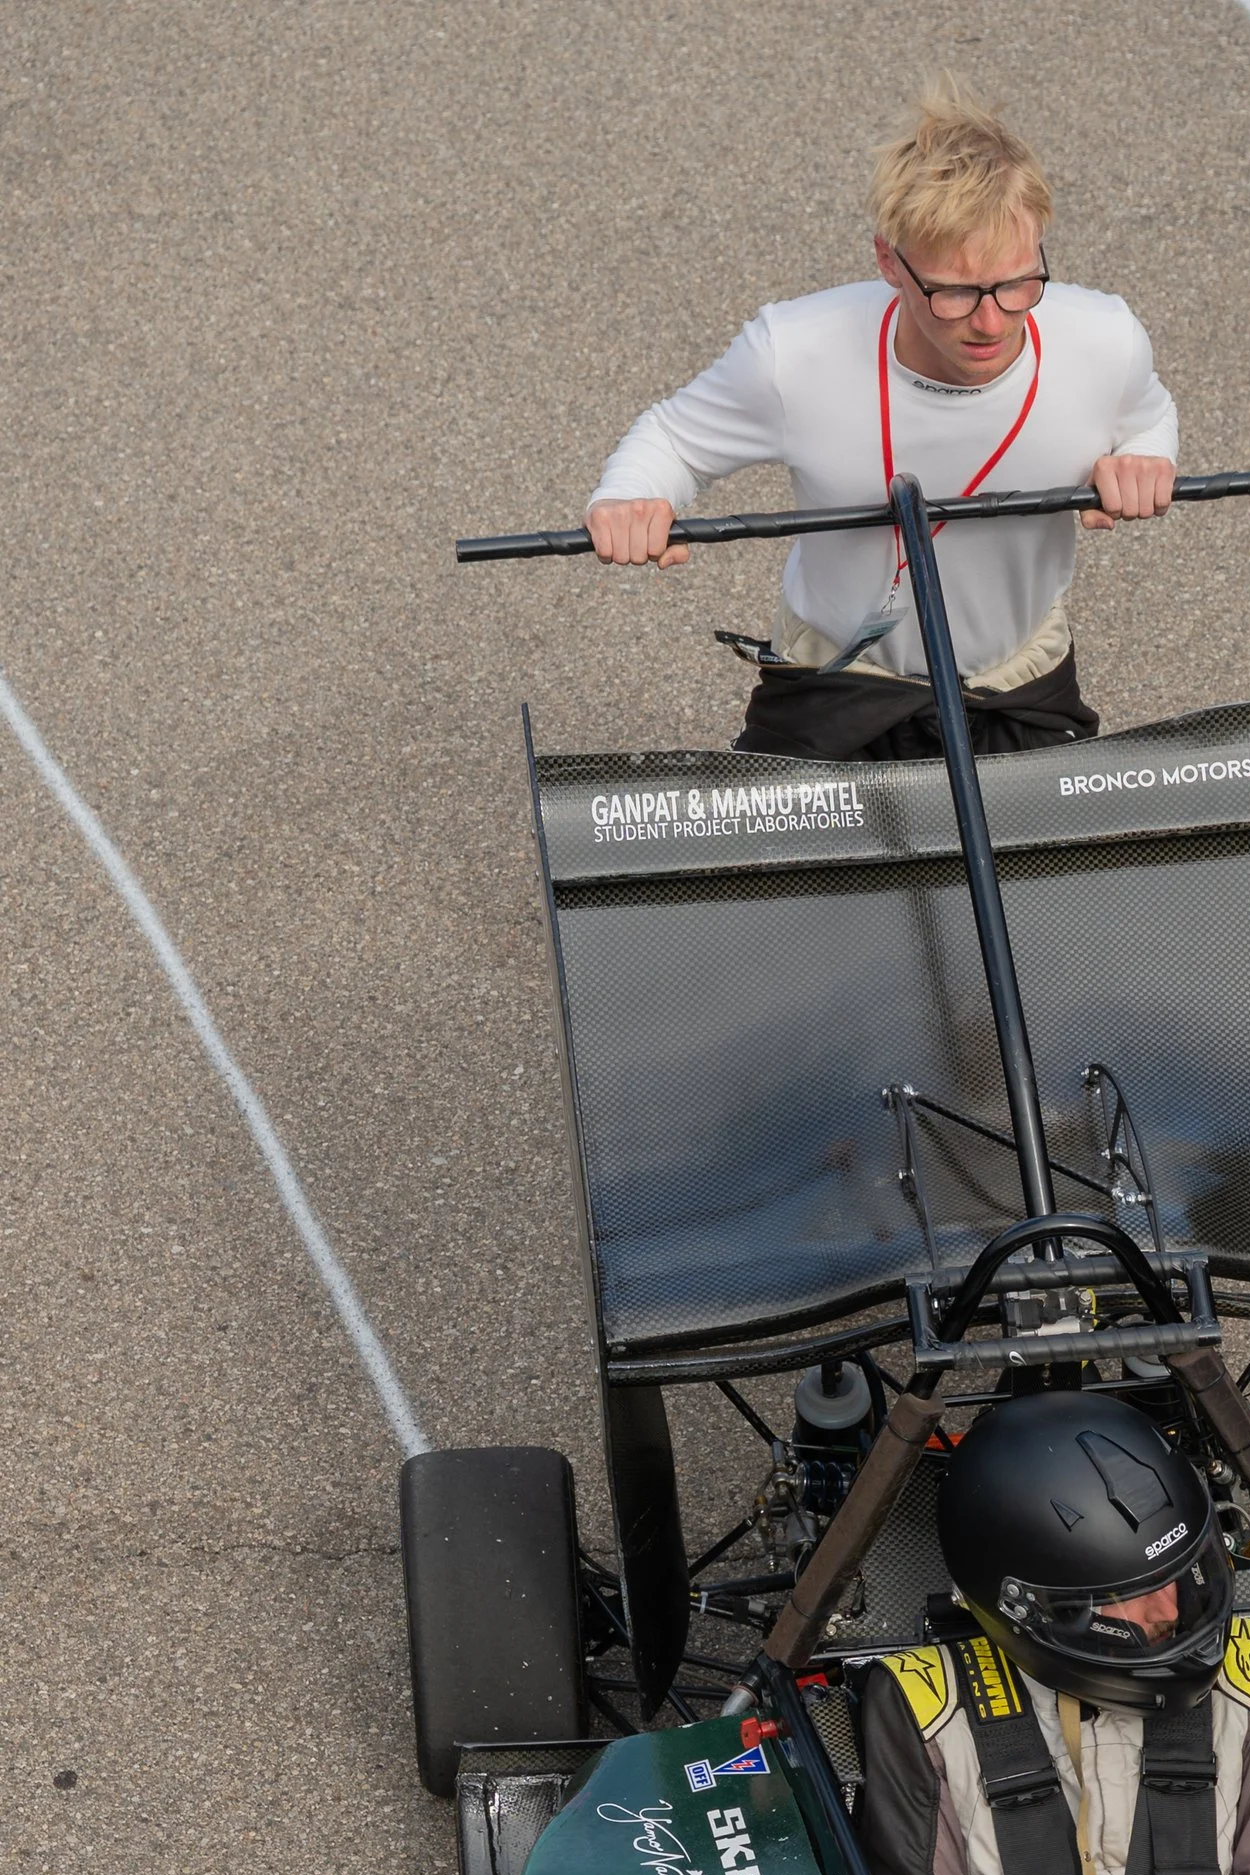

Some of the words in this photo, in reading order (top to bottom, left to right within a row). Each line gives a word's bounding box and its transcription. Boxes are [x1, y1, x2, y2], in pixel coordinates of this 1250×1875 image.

[1059, 769, 1156, 796] BRONCO
[591, 791, 680, 826] GANPAT
[687, 789, 706, 820] &
[712, 785, 794, 818] MANJU
[800, 781, 864, 813] PATEL
[594, 822, 668, 843] STUDENT
[673, 818, 742, 838] PROJECT
[747, 811, 864, 834] LABORATORIES
[1145, 1522, 1189, 1560] sparco
[1090, 1622, 1130, 1639] sparco
[969, 1636, 1010, 1716] CHROTH
[691, 1765, 708, 1787] OFF
